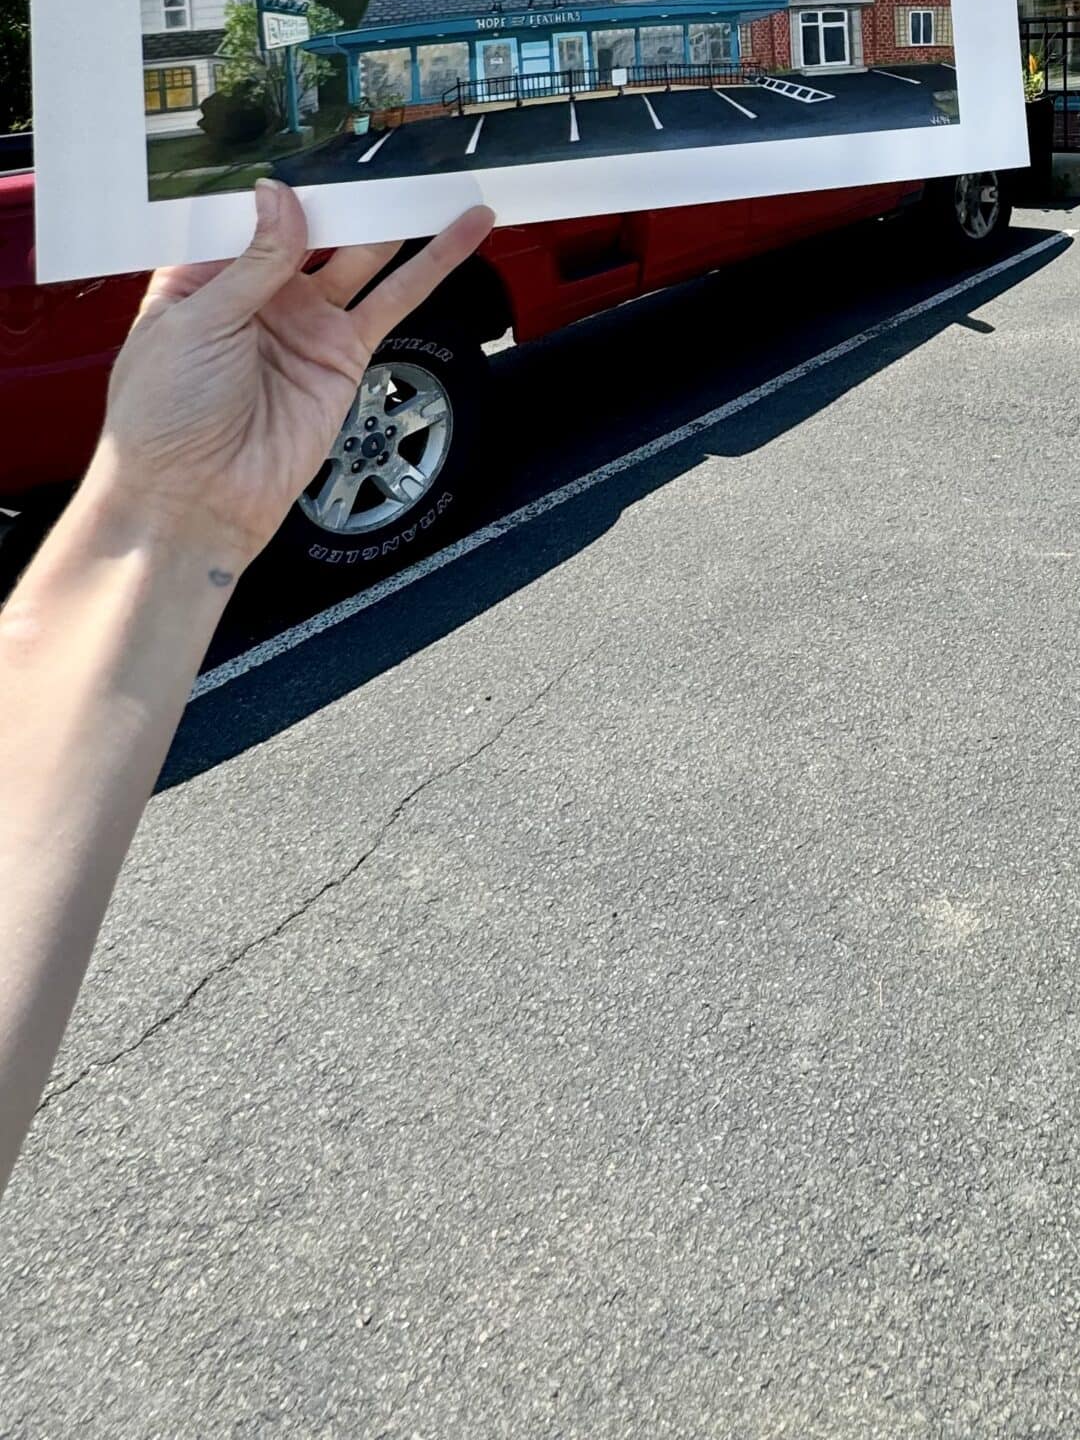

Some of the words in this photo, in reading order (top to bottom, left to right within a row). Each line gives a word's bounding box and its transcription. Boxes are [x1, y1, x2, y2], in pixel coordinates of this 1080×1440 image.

[475, 17, 507, 30] HOPE
[529, 11, 581, 25] FEATHERS
[308, 491, 454, 564] WRANGLER
